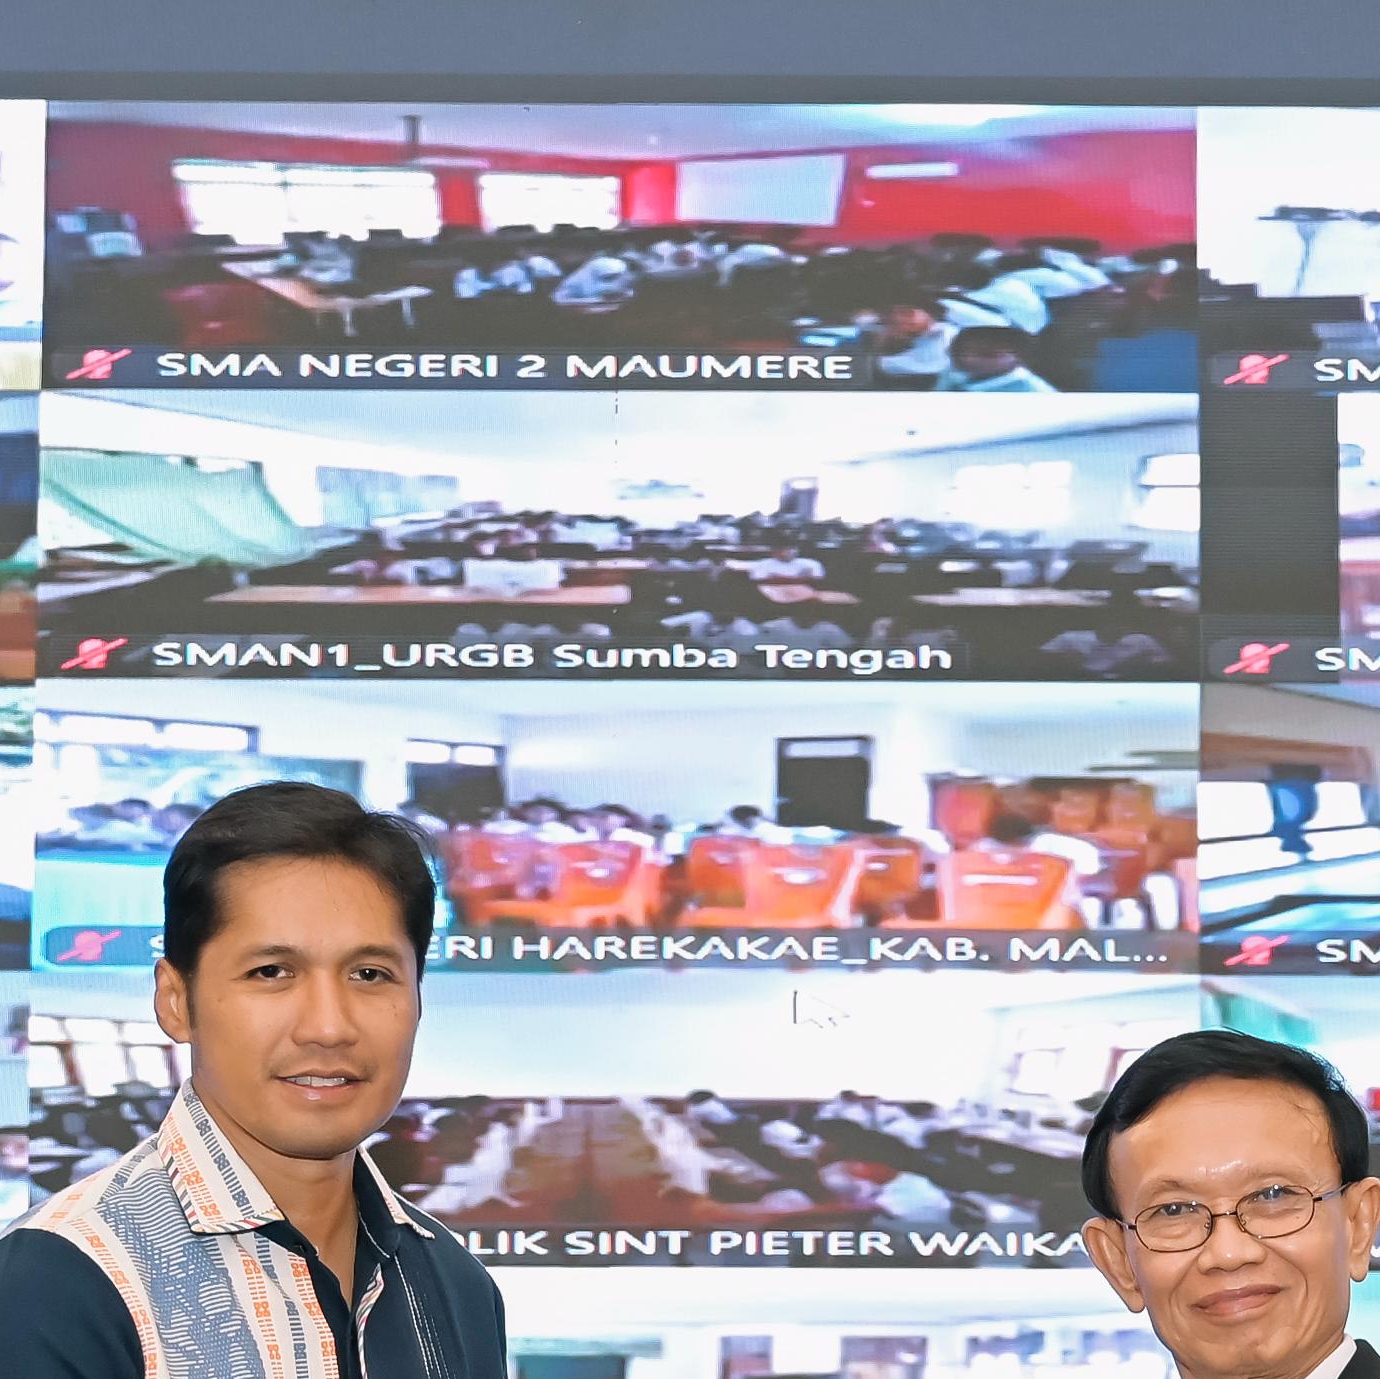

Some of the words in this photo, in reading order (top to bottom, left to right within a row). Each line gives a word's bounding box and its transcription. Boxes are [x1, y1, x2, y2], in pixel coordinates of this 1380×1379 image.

[156, 351, 282, 380] SMA
[300, 351, 501, 381] NEGERI
[517, 354, 546, 381] 2
[566, 354, 854, 382] MAUMERE
[152, 641, 534, 672] SMAN1_URGB
[553, 643, 738, 671] Sumba
[755, 643, 953, 678] Tengah
[424, 935, 494, 963] ERI
[512, 935, 989, 965] HAREKAKAE_KAB.
[1009, 936, 1169, 965] MAL...
[565, 1230, 691, 1258] SINT
[709, 1231, 892, 1258] PIETER
[909, 1231, 1088, 1259] WAIKA
